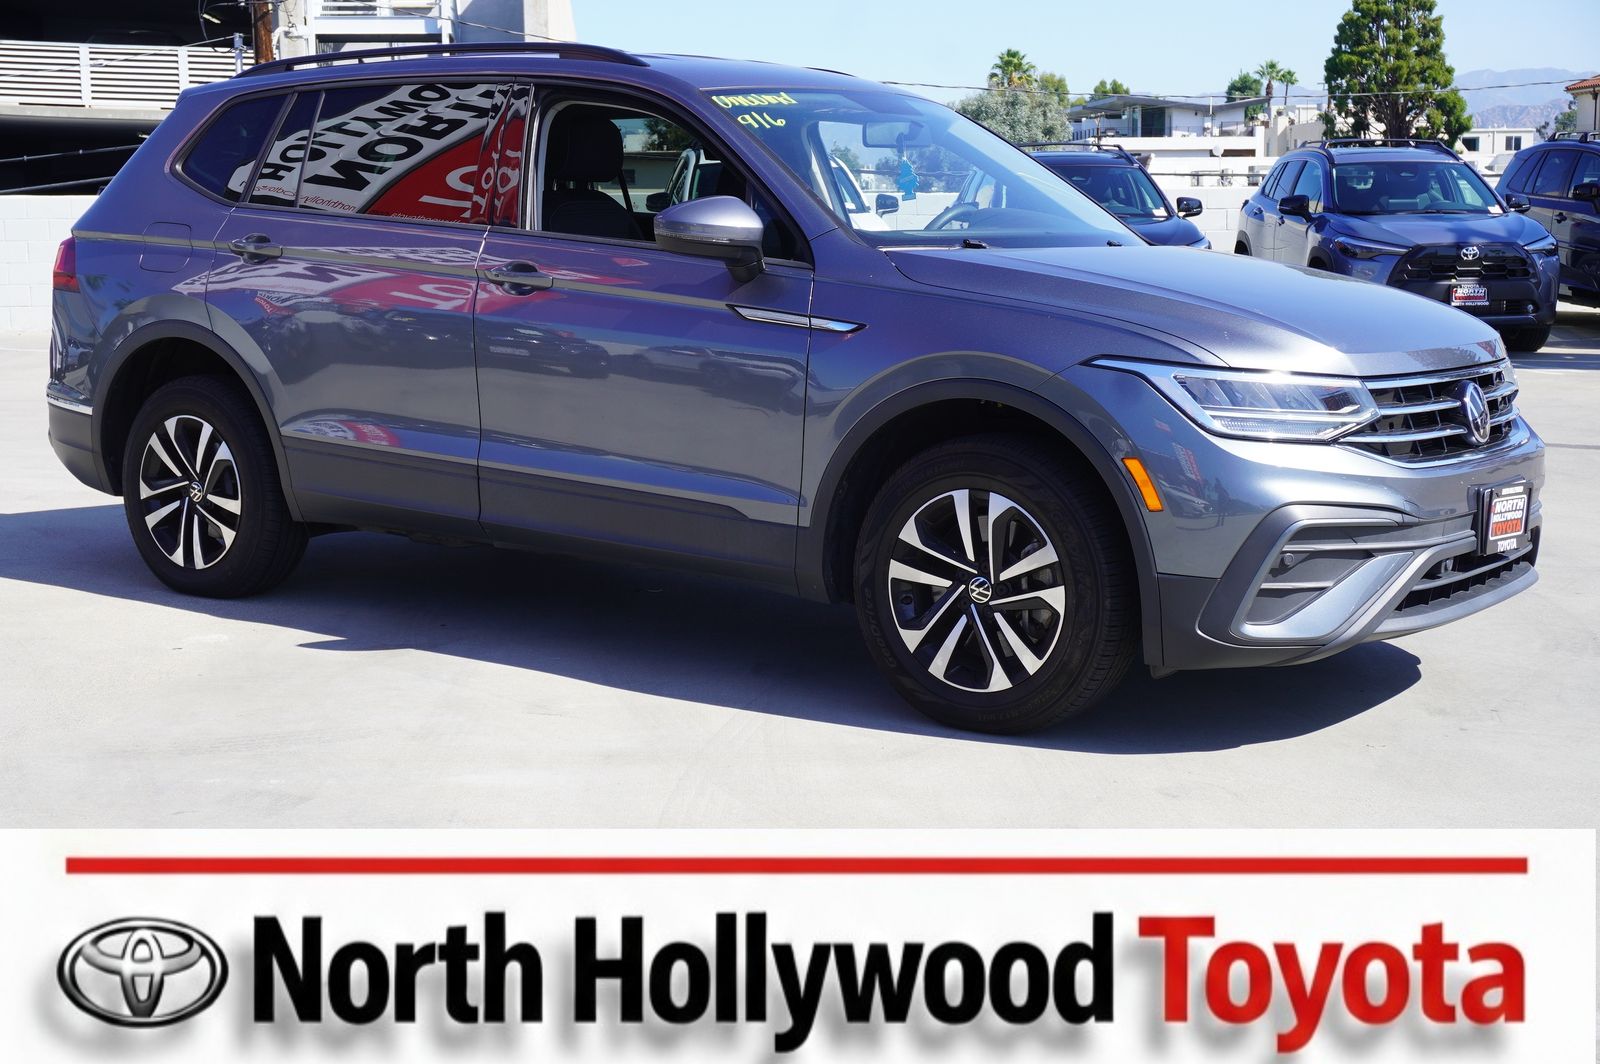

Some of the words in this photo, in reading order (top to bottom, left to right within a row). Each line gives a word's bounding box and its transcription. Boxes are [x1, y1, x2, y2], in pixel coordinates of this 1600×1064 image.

[1495, 498, 1525, 514] NORTH
[1493, 519, 1522, 537] TOYOTA
[1497, 538, 1517, 552] TOYOTA
